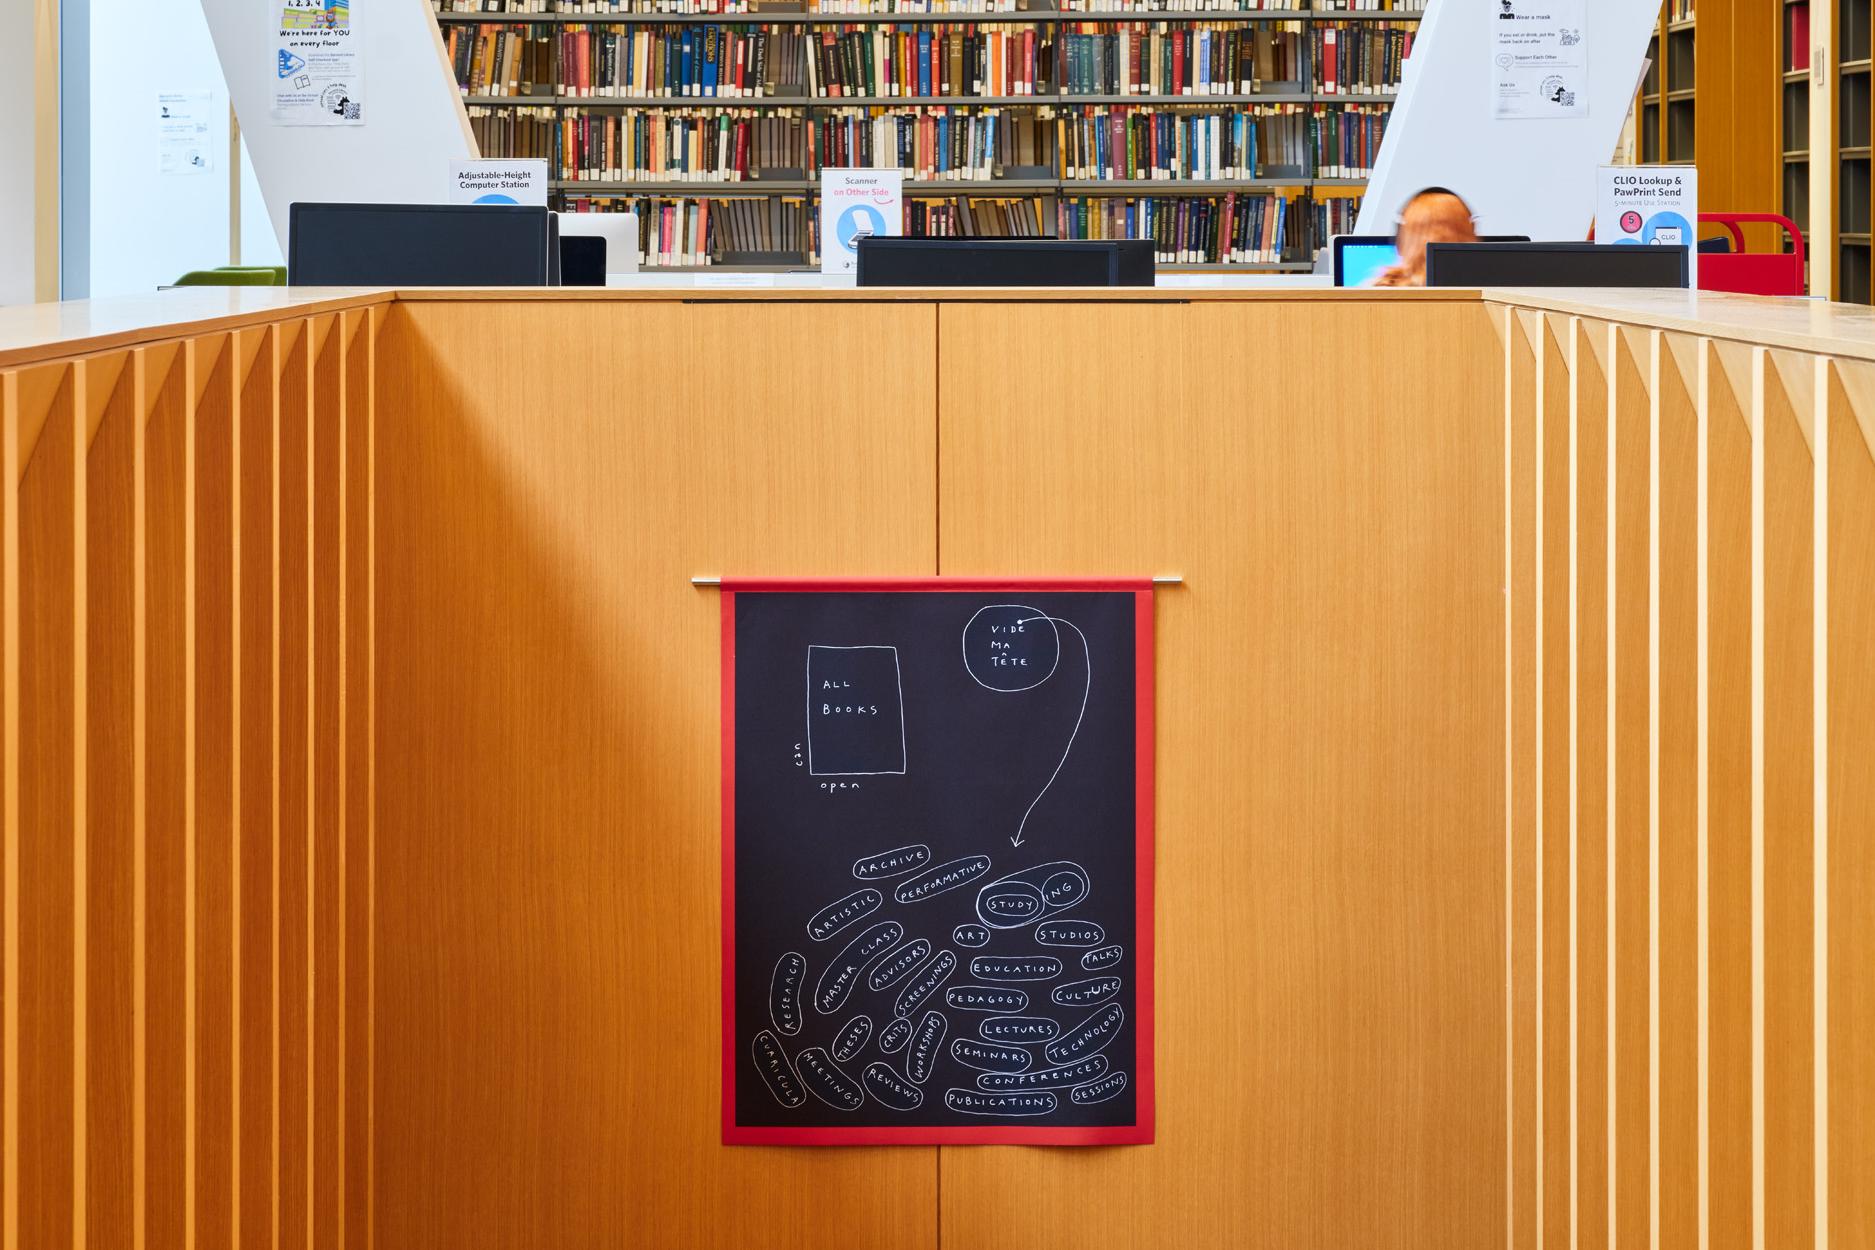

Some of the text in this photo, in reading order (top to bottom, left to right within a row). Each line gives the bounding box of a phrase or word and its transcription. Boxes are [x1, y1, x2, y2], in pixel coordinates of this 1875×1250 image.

[458, 171, 531, 180] Adjustable-Height
[1614, 176, 1636, 184] CLIO
[1639, 176, 1672, 186] Lookup
[1614, 188, 1682, 196] PawPrint Send
[1628, 215, 1634, 224] 5
[991, 641, 1010, 649] MA
[991, 653, 1027, 666] TÊTE
[823, 681, 850, 689] ALL
[823, 704, 877, 715] BOOKS
[794, 743, 803, 766] can
[821, 782, 859, 793] open
[859, 851, 924, 875] ARCHIVE
[901, 862, 984, 902] PERFORMATIVE
[991, 882, 1071, 910] STUDY ING
[814, 895, 875, 937] ARTISTIC
[956, 932, 985, 940] ART
[1040, 930, 1099, 940] STUDIOS
[875, 945, 926, 987] ADVISORS
[1085, 948, 1120, 963] TALKS
[823, 928, 897, 1008] MASTER CLASS
[974, 964, 1056, 972] EDUCATION
[782, 959, 800, 1030] RESEARCH
[899, 956, 952, 1015] SCREENINGS
[1056, 980, 1118, 1001] CULTURE
[949, 993, 1023, 1005] PEDAGOGY
[838, 1021, 869, 1059] THESES
[884, 1024, 908, 1047] CRITS
[985, 1026, 1052, 1034] LECTURES
[1049, 1007, 1120, 1058] TECHNOLOGY
[915, 1017, 940, 1078] WORKSHOPS
[956, 1044, 1025, 1062] SEMINARS
[760, 1035, 798, 1104] CURRICULA
[803, 1052, 859, 1105] MEETINGS
[983, 1060, 1100, 1085] CONFERENCES
[867, 1069, 919, 1102] REVIEWS
[1075, 1075, 1124, 1100] SESSIONS
[949, 1094, 1053, 1107] PUBLICATIONS
